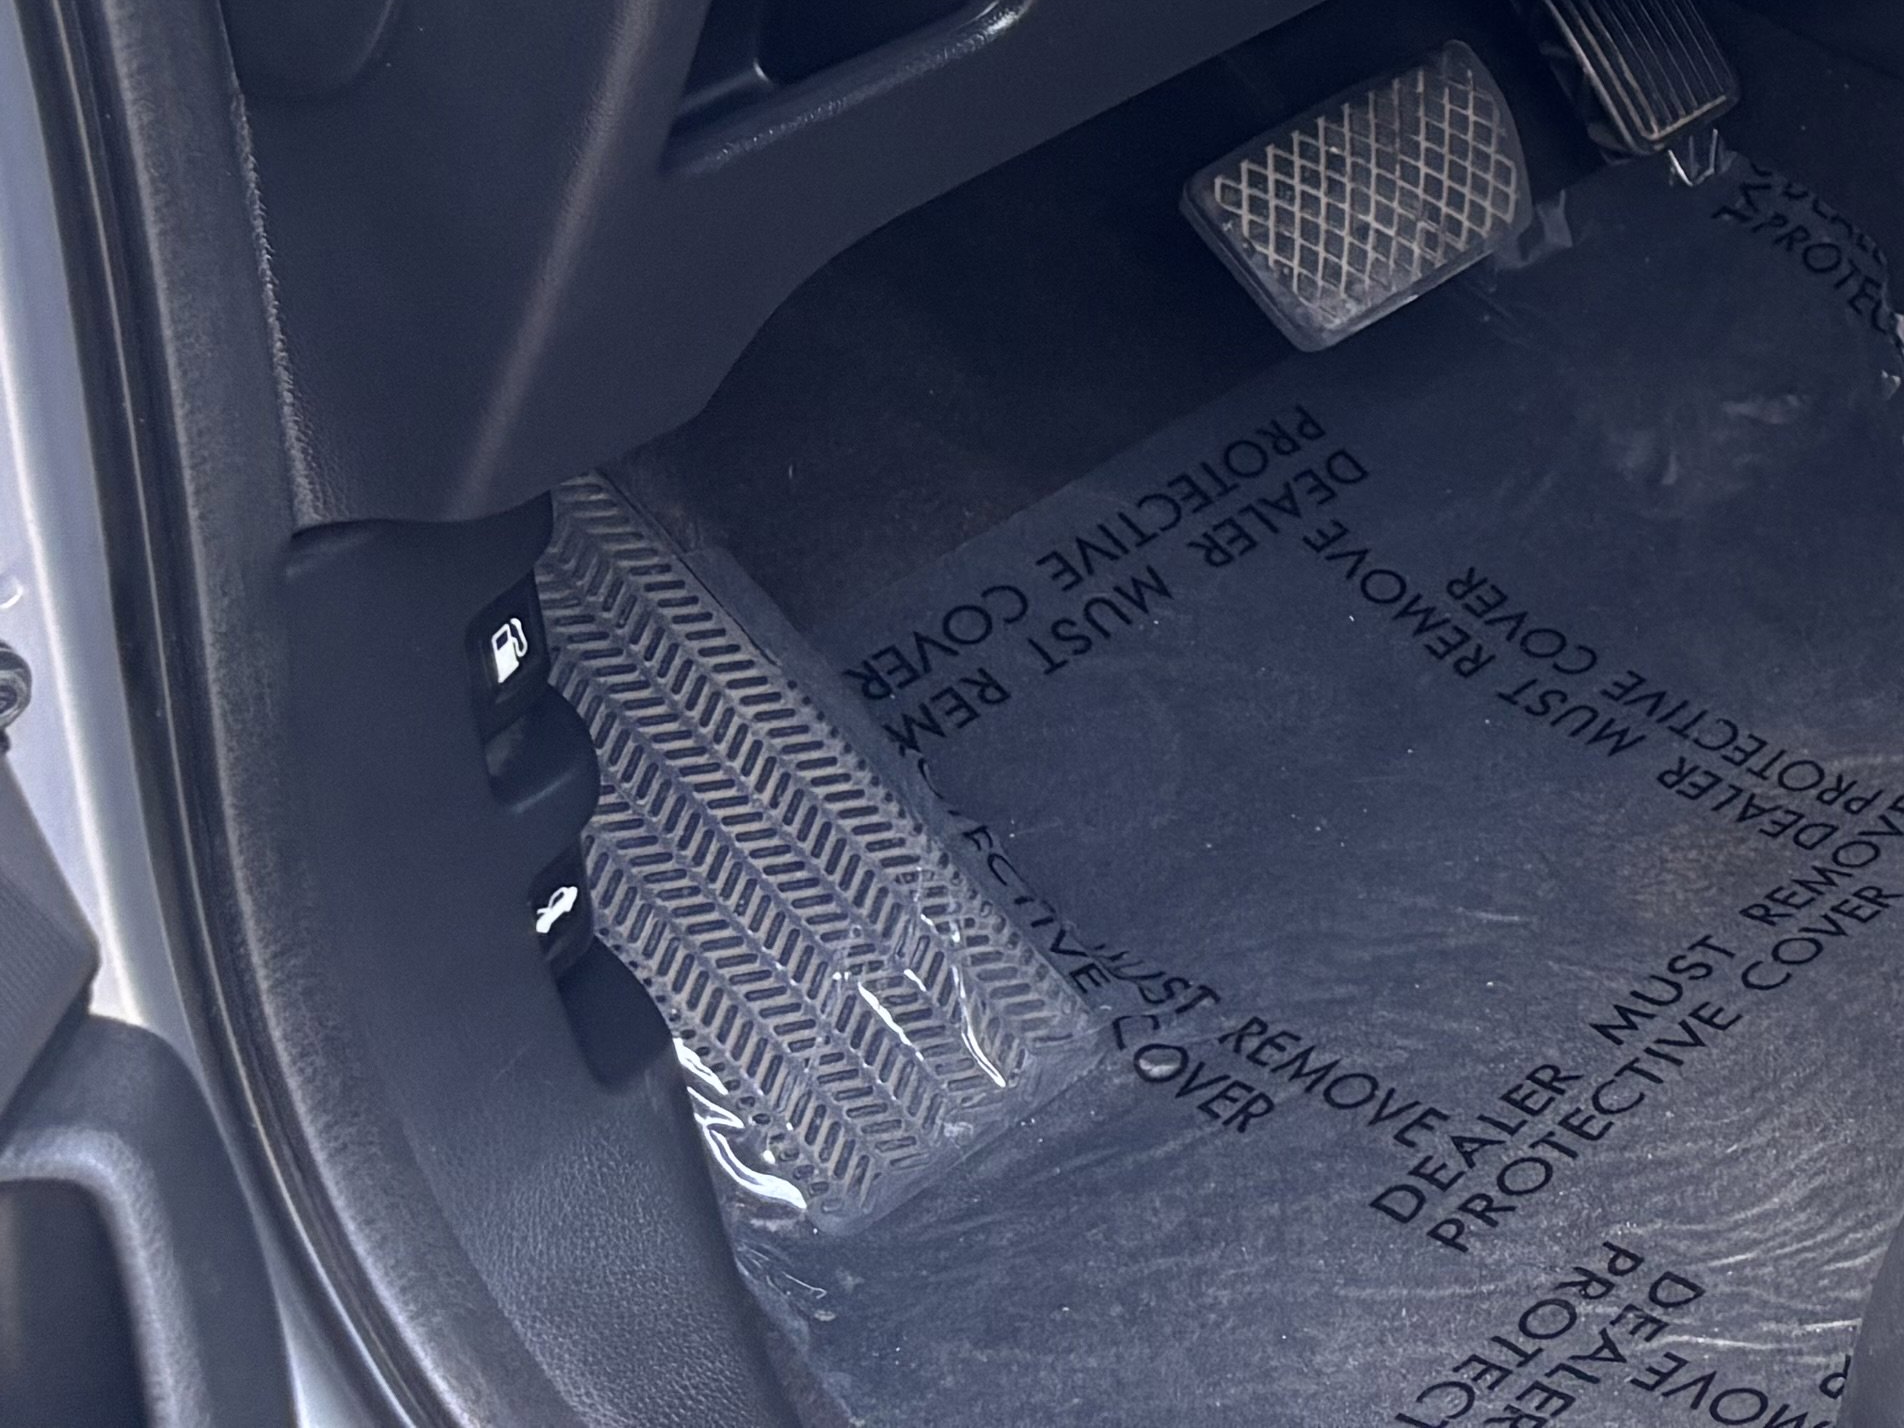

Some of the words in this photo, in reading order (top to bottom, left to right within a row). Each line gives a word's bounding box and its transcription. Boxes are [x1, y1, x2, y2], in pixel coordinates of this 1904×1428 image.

[1036, 405, 1327, 592] PROTECTIVE
[1187, 448, 1369, 568] DEALER
[841, 584, 1029, 701] COVER
[1027, 565, 1174, 676] MUST
[1302, 519, 1497, 678] REMOVE
[1446, 567, 1598, 675] COVER
[1498, 678, 1645, 758] MUST
[1600, 670, 1887, 815] PROTECTIVE
[1655, 756, 1840, 852] DEALER
[1112, 1013, 1275, 1133] COVER
[1218, 1015, 1451, 1148] REMOVE
[1369, 1062, 1584, 1224] DEALER
[1589, 934, 1735, 1045] MUST
[1427, 1000, 1743, 1254] PROTECTIVE
[1741, 884, 1904, 991] COVER
